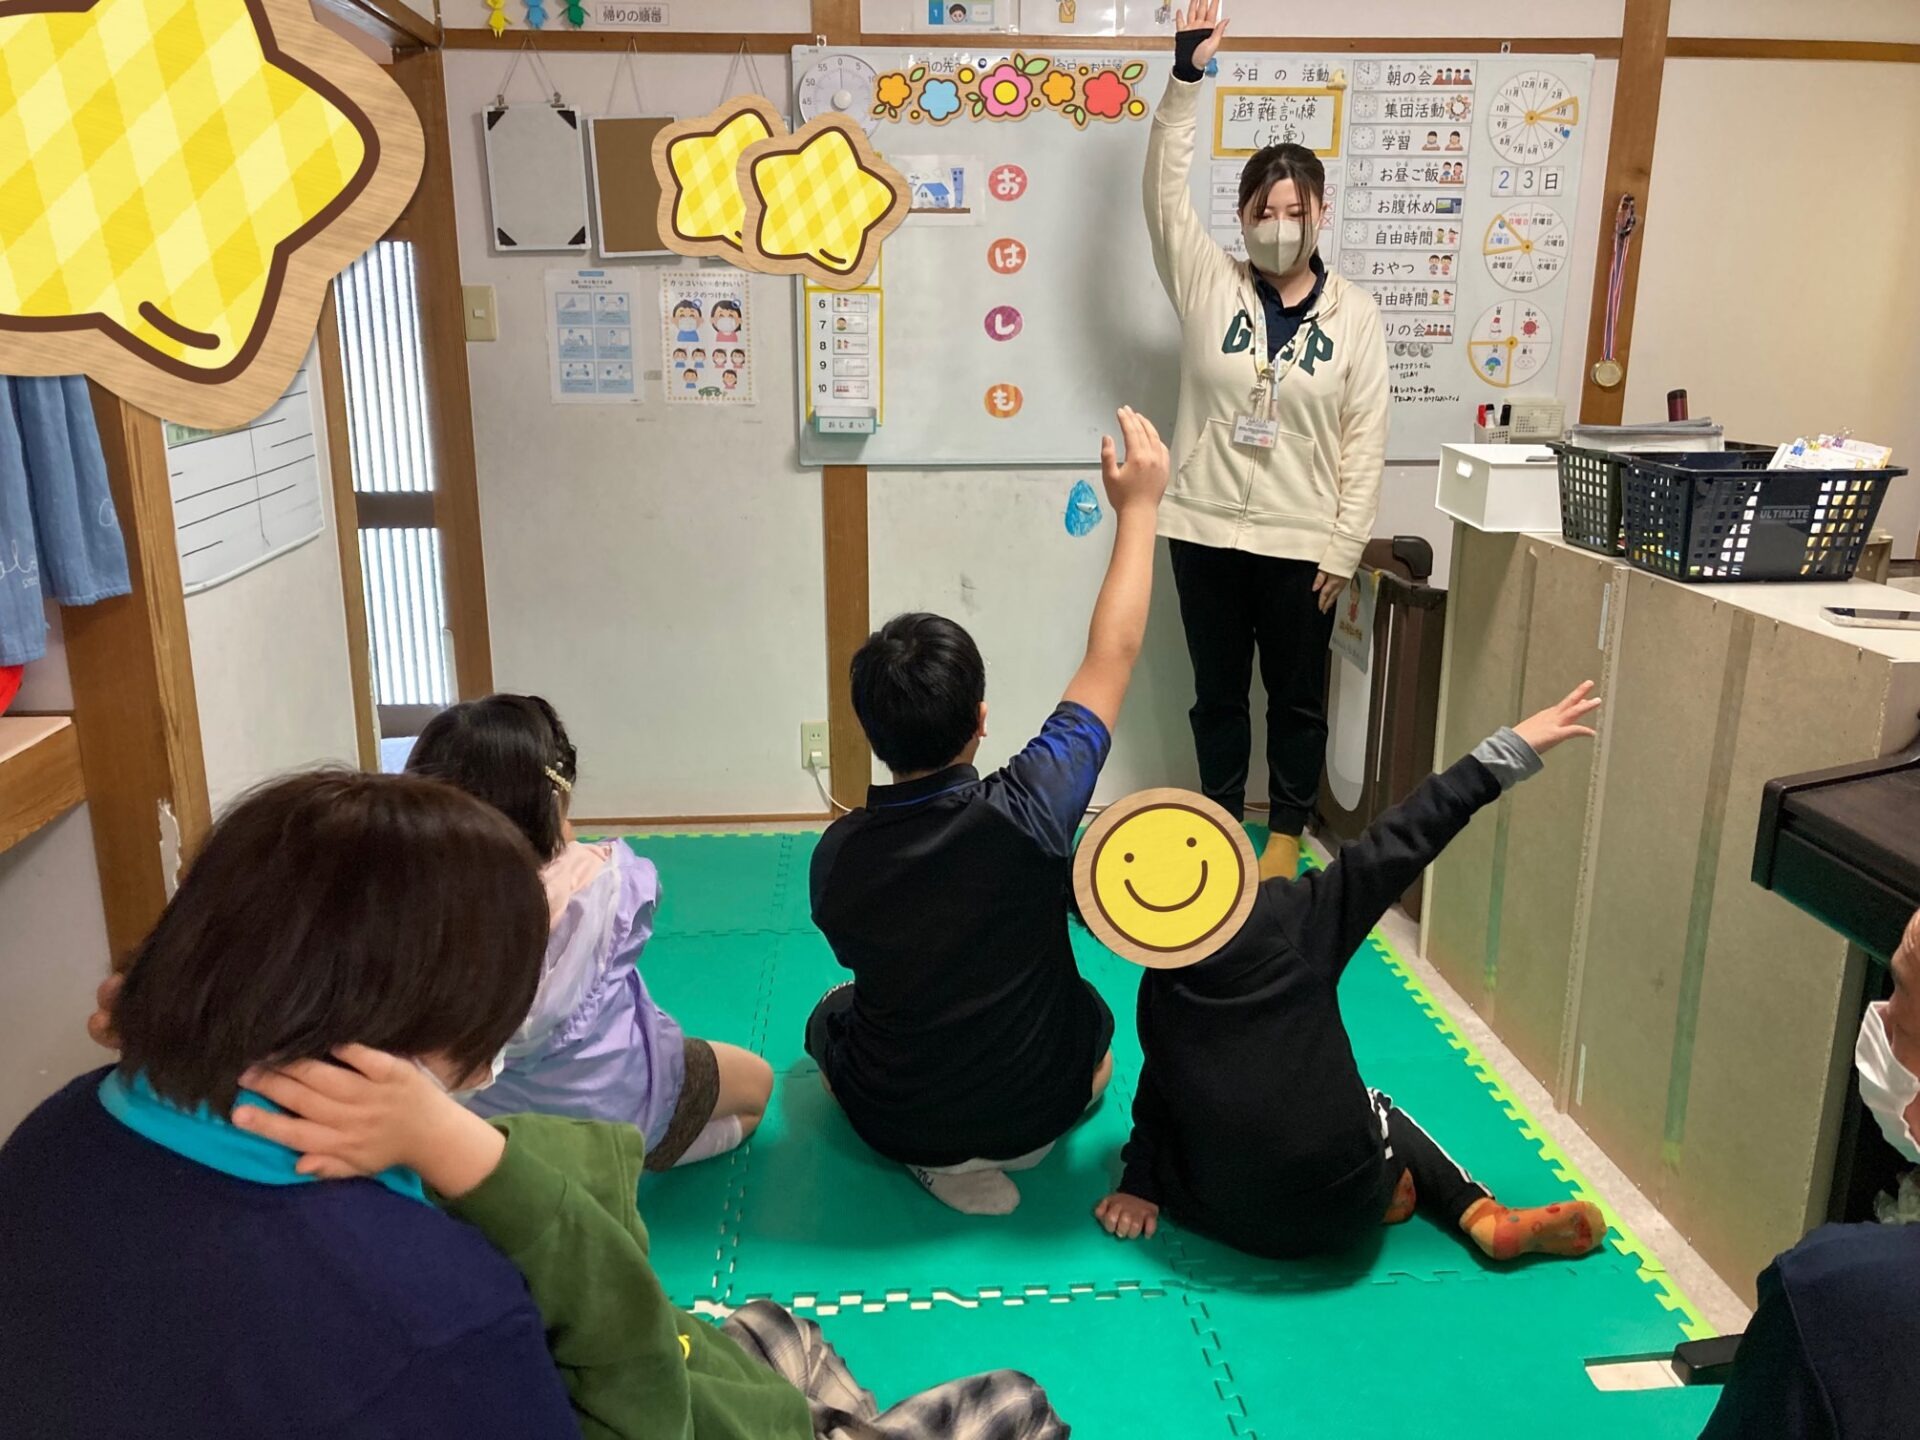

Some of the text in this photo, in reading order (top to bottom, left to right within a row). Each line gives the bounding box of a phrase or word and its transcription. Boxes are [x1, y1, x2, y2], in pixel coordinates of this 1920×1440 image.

[603, 9, 661, 23] 帰りの順番
[838, 58, 843, 66] 0
[855, 62, 861, 70] 5
[1233, 68, 1330, 82] 今日 の 活動
[1386, 70, 1432, 86] 朝の会
[806, 78, 816, 86] 50
[1521, 80, 1535, 88] 12月
[1538, 81, 1549, 89] 1月
[1505, 88, 1519, 97] 11月
[1552, 90, 1562, 99] 2月
[1229, 102, 1316, 122] 避難訓練
[1384, 103, 1445, 119] 集団活動
[1496, 105, 1510, 113] 10月
[1497, 120, 1508, 129] 9月
[1382, 135, 1411, 151] 学習
[1500, 137, 1510, 146] 8月
[1543, 141, 1554, 149] 5月
[1513, 145, 1523, 154] 7月
[1527, 146, 1538, 155] 6月
[1380, 168, 1439, 183] お昼ご飯
[1498, 170, 1510, 189] 2
[1523, 170, 1534, 189] 3
[997, 168, 1022, 195] お
[1545, 173, 1558, 190] 日
[1377, 200, 1435, 215] お腹休め
[1532, 218, 1552, 226] 月曜日
[1375, 231, 1433, 245] 自由時間
[994, 243, 1022, 268] は
[1372, 262, 1415, 275] おやつ
[1537, 263, 1557, 271] 水曜日
[1512, 275, 1532, 283] 木曜日
[1372, 292, 1428, 307] 自由時間
[819, 300, 826, 309] 6
[820, 321, 827, 330] 7
[995, 313, 1015, 335] し
[819, 341, 827, 351] 8
[819, 361, 827, 370] 9
[818, 384, 827, 393] 10
[993, 389, 1015, 411] も
[828, 421, 866, 429] おしまい
[1759, 509, 1810, 519] ULTIMATE
